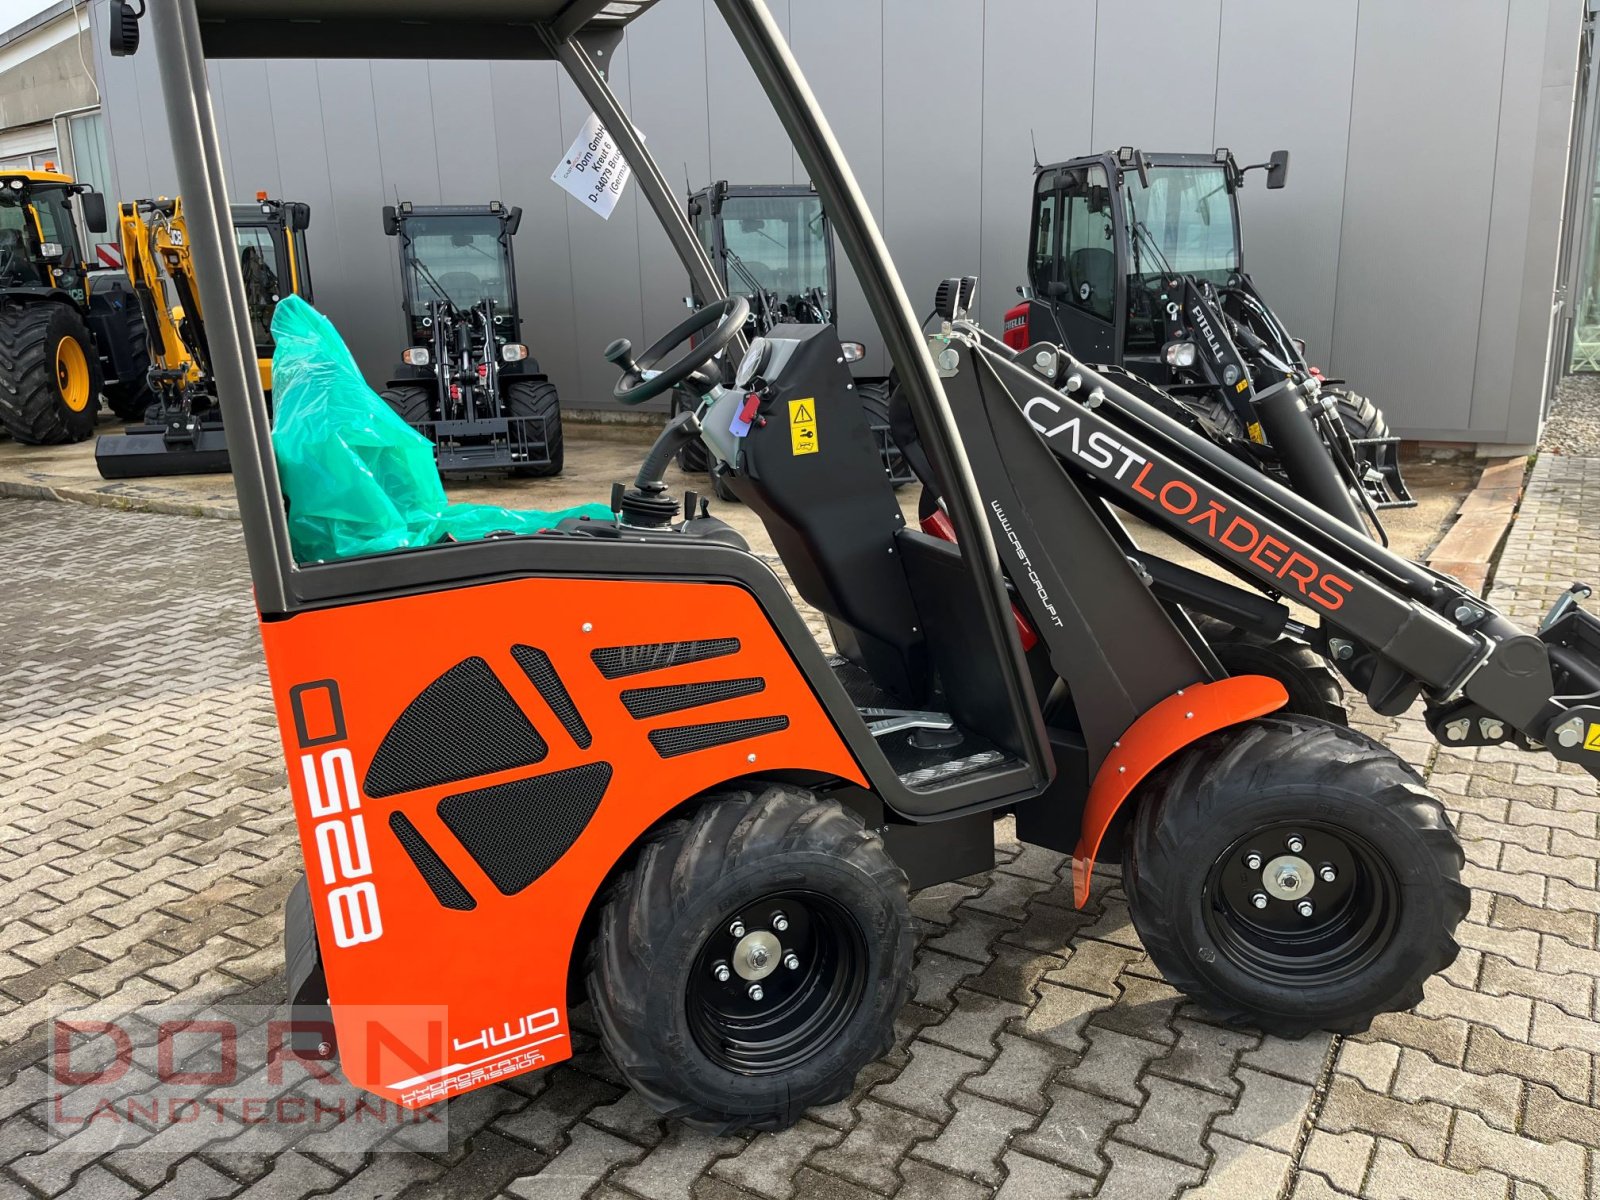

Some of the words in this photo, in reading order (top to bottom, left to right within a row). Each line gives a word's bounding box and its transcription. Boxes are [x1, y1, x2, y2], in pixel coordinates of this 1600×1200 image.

[575, 152, 594, 172] Dorn
[589, 124, 606, 152] GmbH
[592, 149, 608, 172] Kreut
[604, 141, 612, 150] 6
[588, 193, 599, 203] D-
[594, 168, 613, 193] 84079
[608, 149, 622, 169] Bruc
[1192, 305, 1224, 363] PITBULL
[453, 1007, 560, 1051] 4WD
[401, 1049, 541, 1101] HYDROSTATIC
